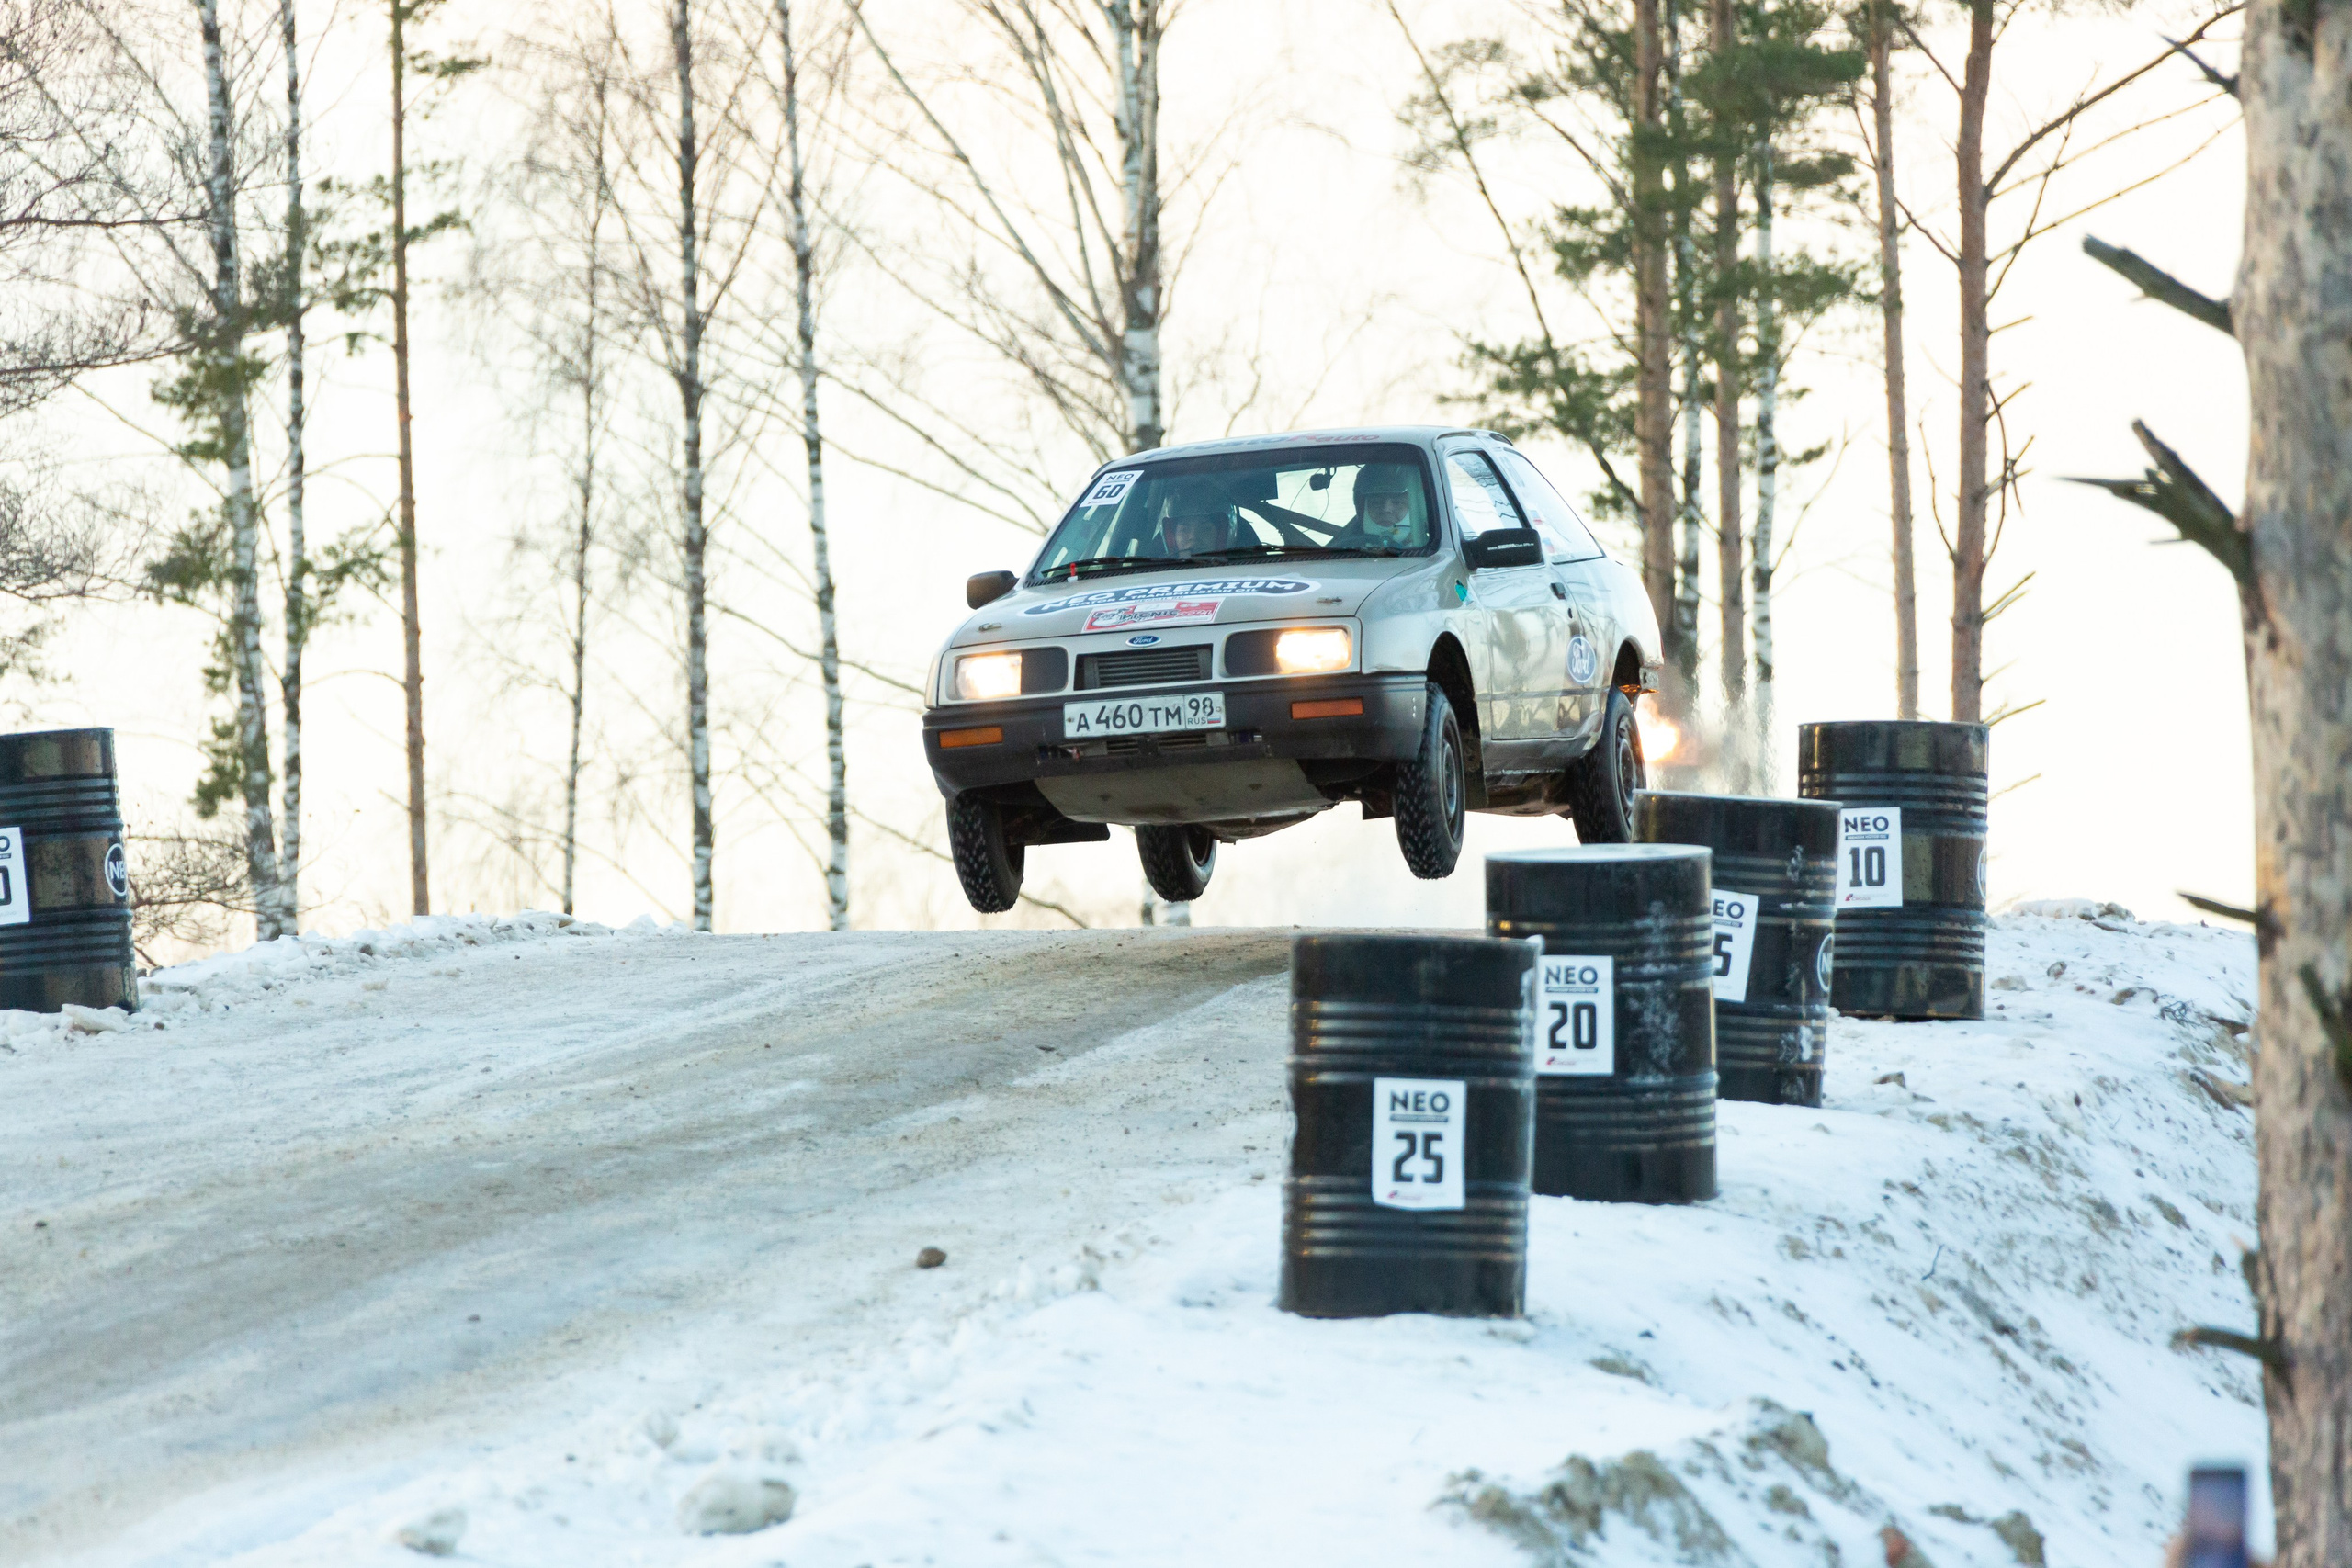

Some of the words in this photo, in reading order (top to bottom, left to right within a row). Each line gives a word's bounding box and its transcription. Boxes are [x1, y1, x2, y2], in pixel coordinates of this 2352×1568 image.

[1106, 473, 1135, 482] NEO
[1091, 483, 1127, 500] 60
[1040, 592, 1115, 611] NEO
[1123, 581, 1296, 598] PREMIUM
[1069, 597, 1116, 607] MOTOR
[1131, 589, 1233, 600] TRANSMISSION
[1119, 608, 1180, 623] PICNIC
[1132, 637, 1154, 645] Ford
[1188, 696, 1214, 717] 98
[1187, 716, 1207, 725] RUS
[1844, 815, 1890, 833] NEO
[108, 860, 126, 880] NE
[1849, 845, 1886, 888] 10
[1712, 898, 1745, 919] EO
[1713, 931, 1733, 977] 5
[1544, 965, 1599, 985] NEO
[1548, 1000, 1597, 1050] 20
[1389, 1090, 1450, 1113] NEO
[1393, 1131, 1443, 1184] 25
